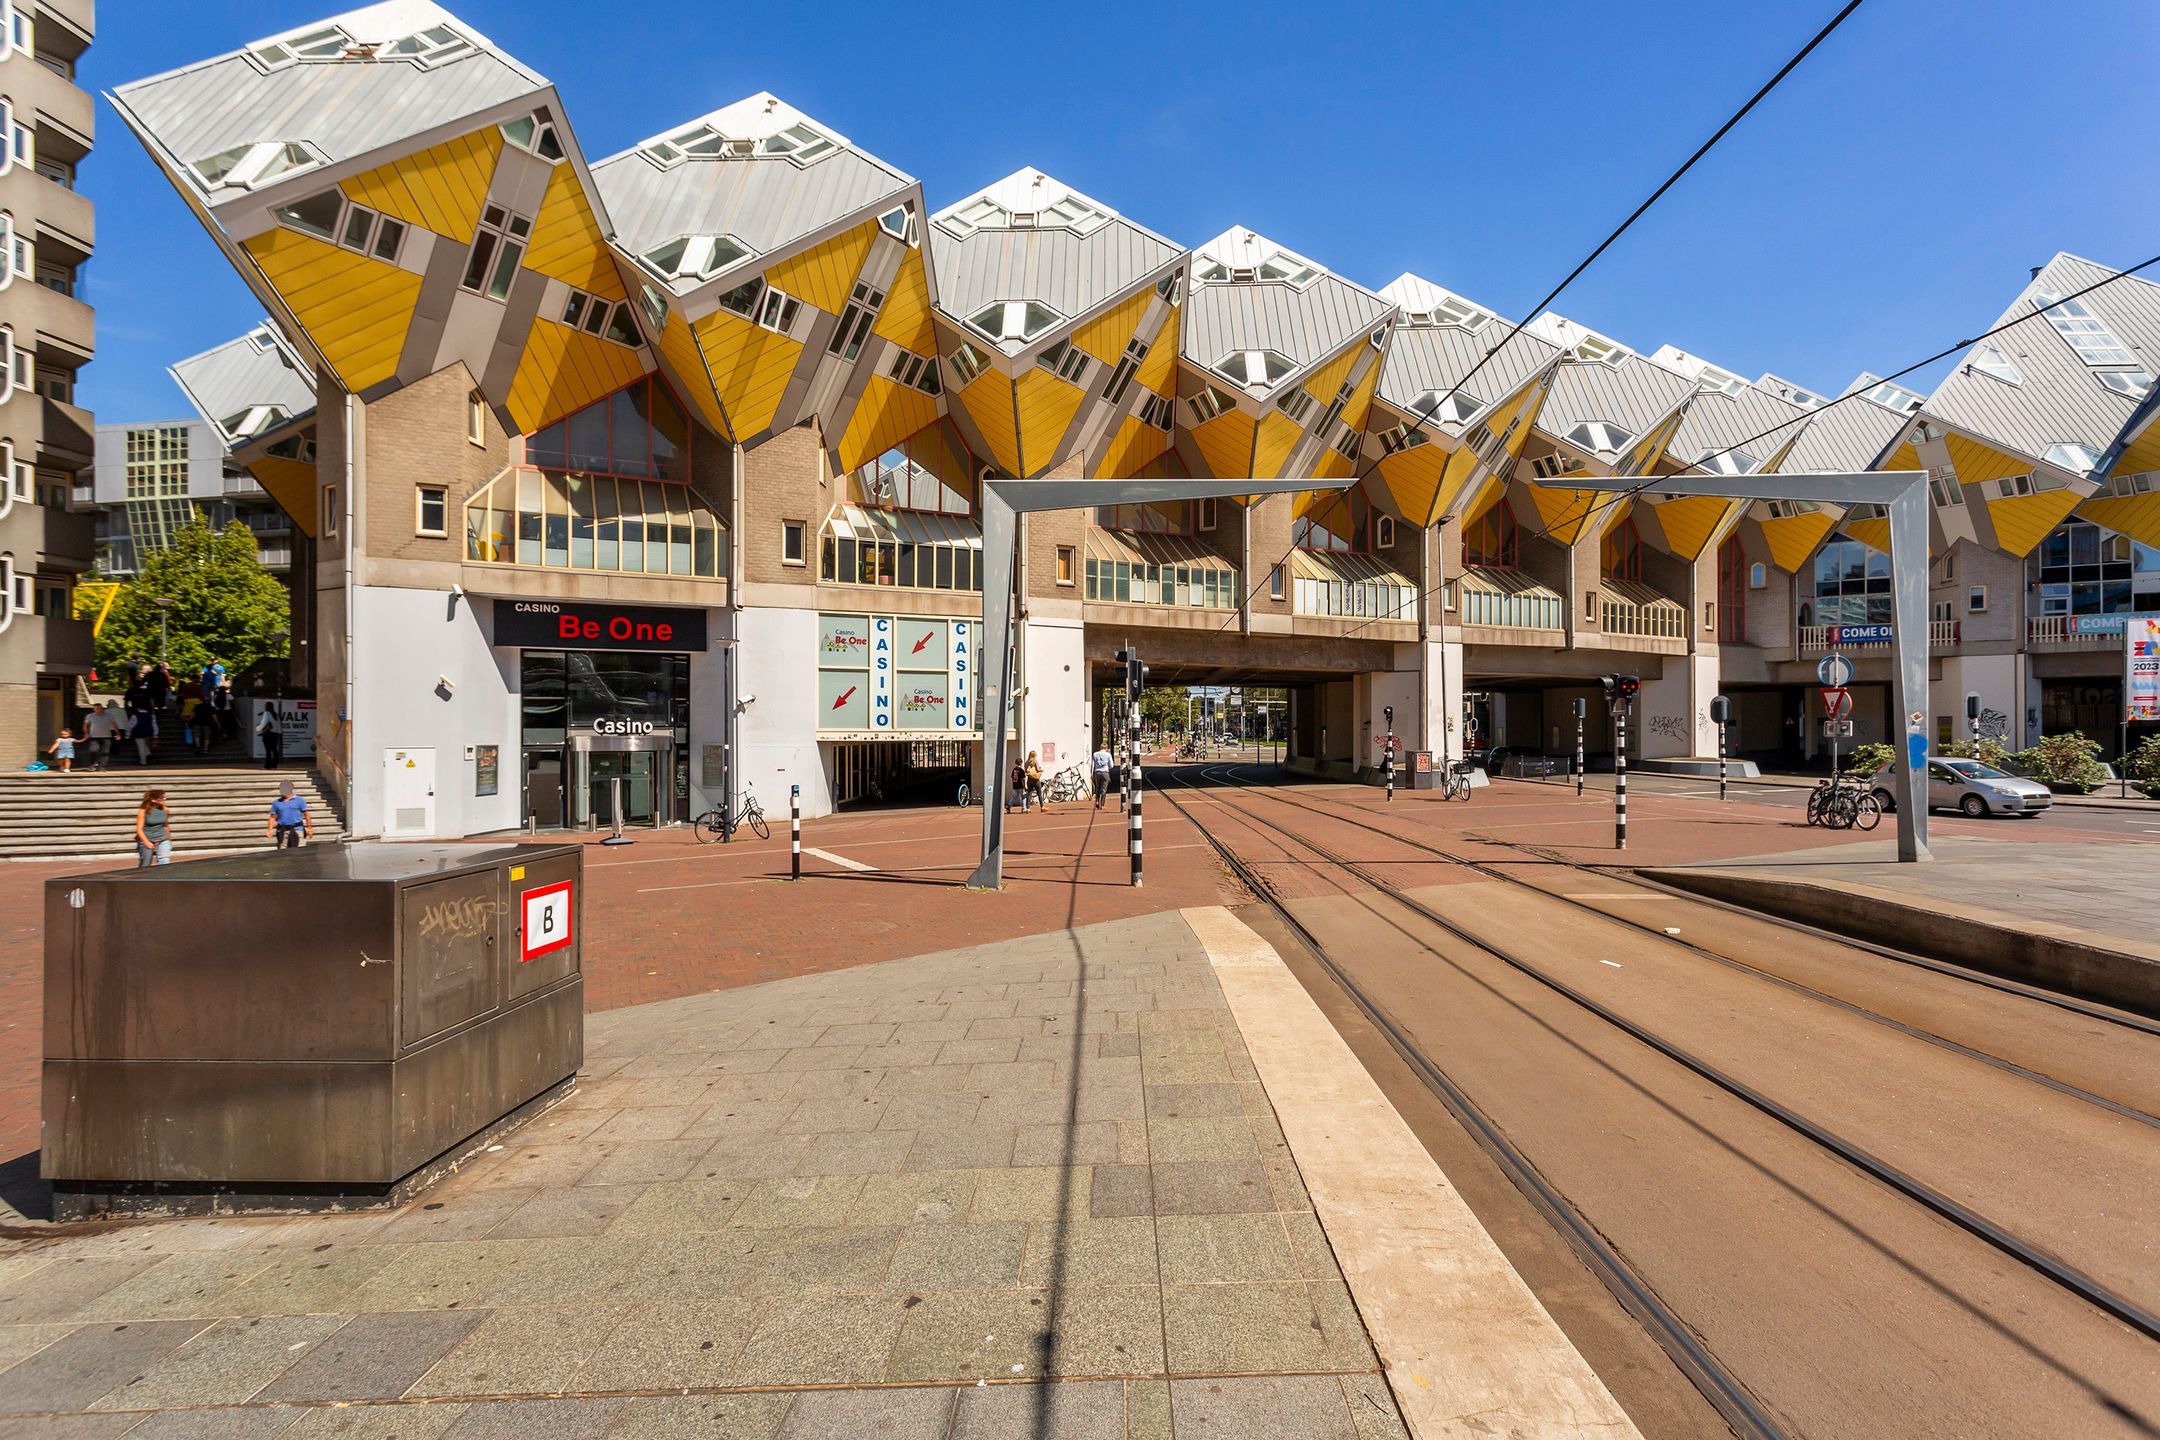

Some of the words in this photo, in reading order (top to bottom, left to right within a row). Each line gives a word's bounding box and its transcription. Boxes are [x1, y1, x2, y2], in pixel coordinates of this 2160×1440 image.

[515, 603, 560, 613] CASINO
[559, 615, 600, 638] Be
[609, 616, 673, 641] One
[2081, 617, 2124, 628] COME
[1842, 627, 1877, 637] COME
[1880, 626, 1892, 636] O
[835, 636, 846, 644] Be
[849, 637, 867, 645] One
[876, 619, 889, 726] CASINO
[955, 623, 967, 726] CASINO
[913, 695, 924, 703] Be
[926, 695, 944, 703] One
[593, 717, 653, 733] Casino
[543, 905, 554, 934] B
